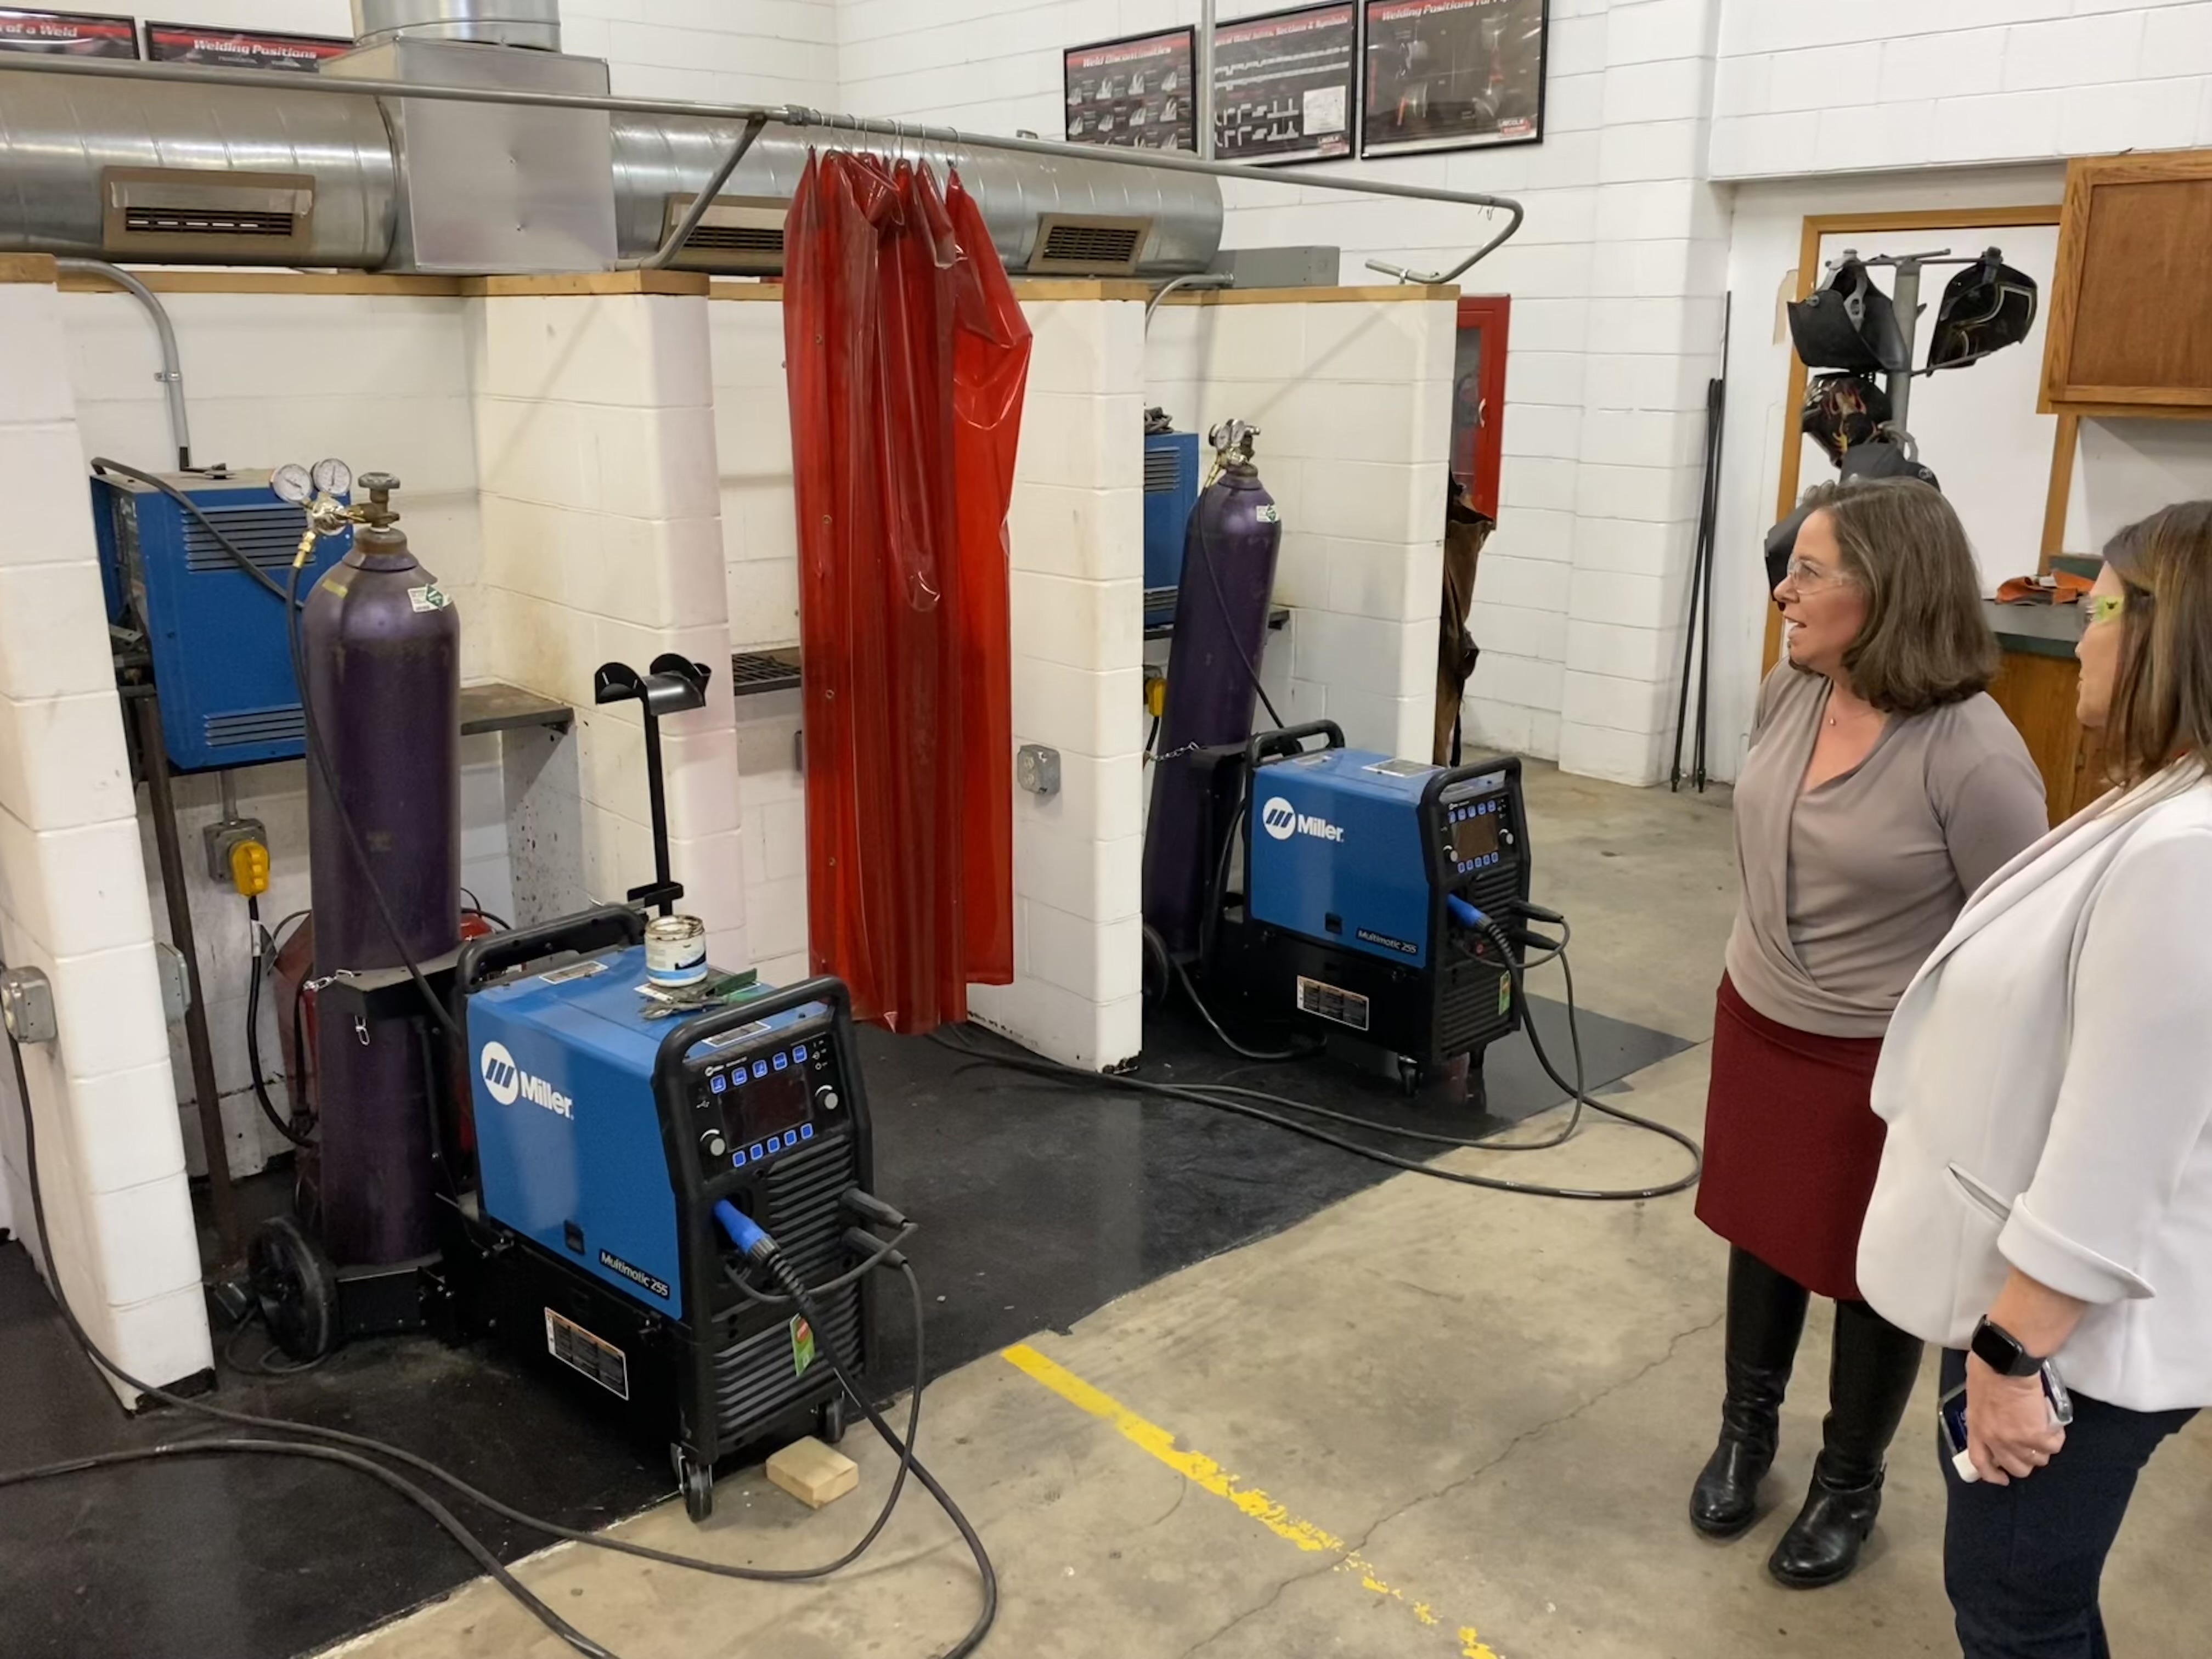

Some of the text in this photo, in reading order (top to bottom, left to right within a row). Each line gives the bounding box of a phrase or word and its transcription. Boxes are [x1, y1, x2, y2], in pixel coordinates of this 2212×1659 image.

[1382, 7, 1422, 21] Welding
[1423, 0, 1473, 15] Positions
[6, 24, 21, 33] of
[40, 25, 78, 37] Weld
[194, 39, 317, 59] Welding Positions
[1297, 814, 1344, 842] Miller
[520, 1070, 572, 1118] Miller
[601, 1251, 668, 1296] Multimatic 255
